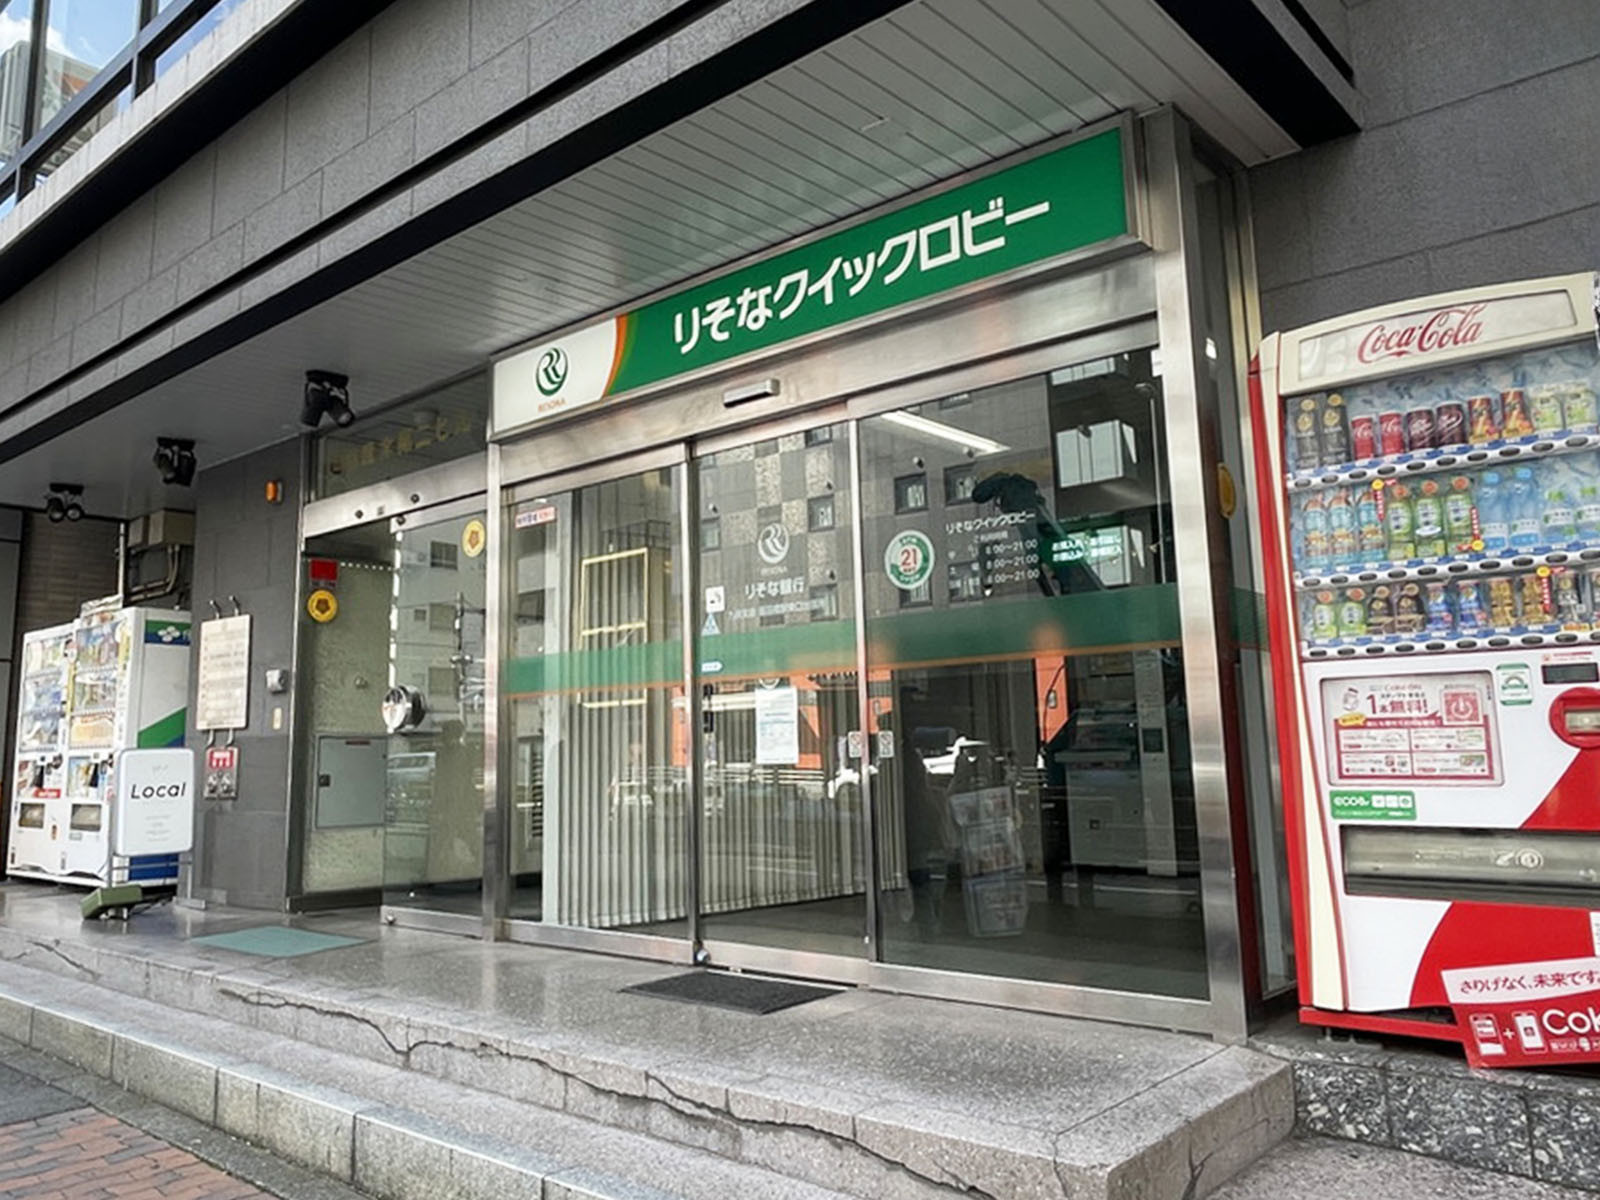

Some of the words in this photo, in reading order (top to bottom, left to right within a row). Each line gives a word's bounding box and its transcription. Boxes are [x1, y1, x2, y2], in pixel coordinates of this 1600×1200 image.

[674, 197, 1050, 354] りそなクイックロビー
[1358, 303, 1487, 364] Coca-Cola
[901, 548, 917, 566] 21
[131, 782, 186, 799] Local
